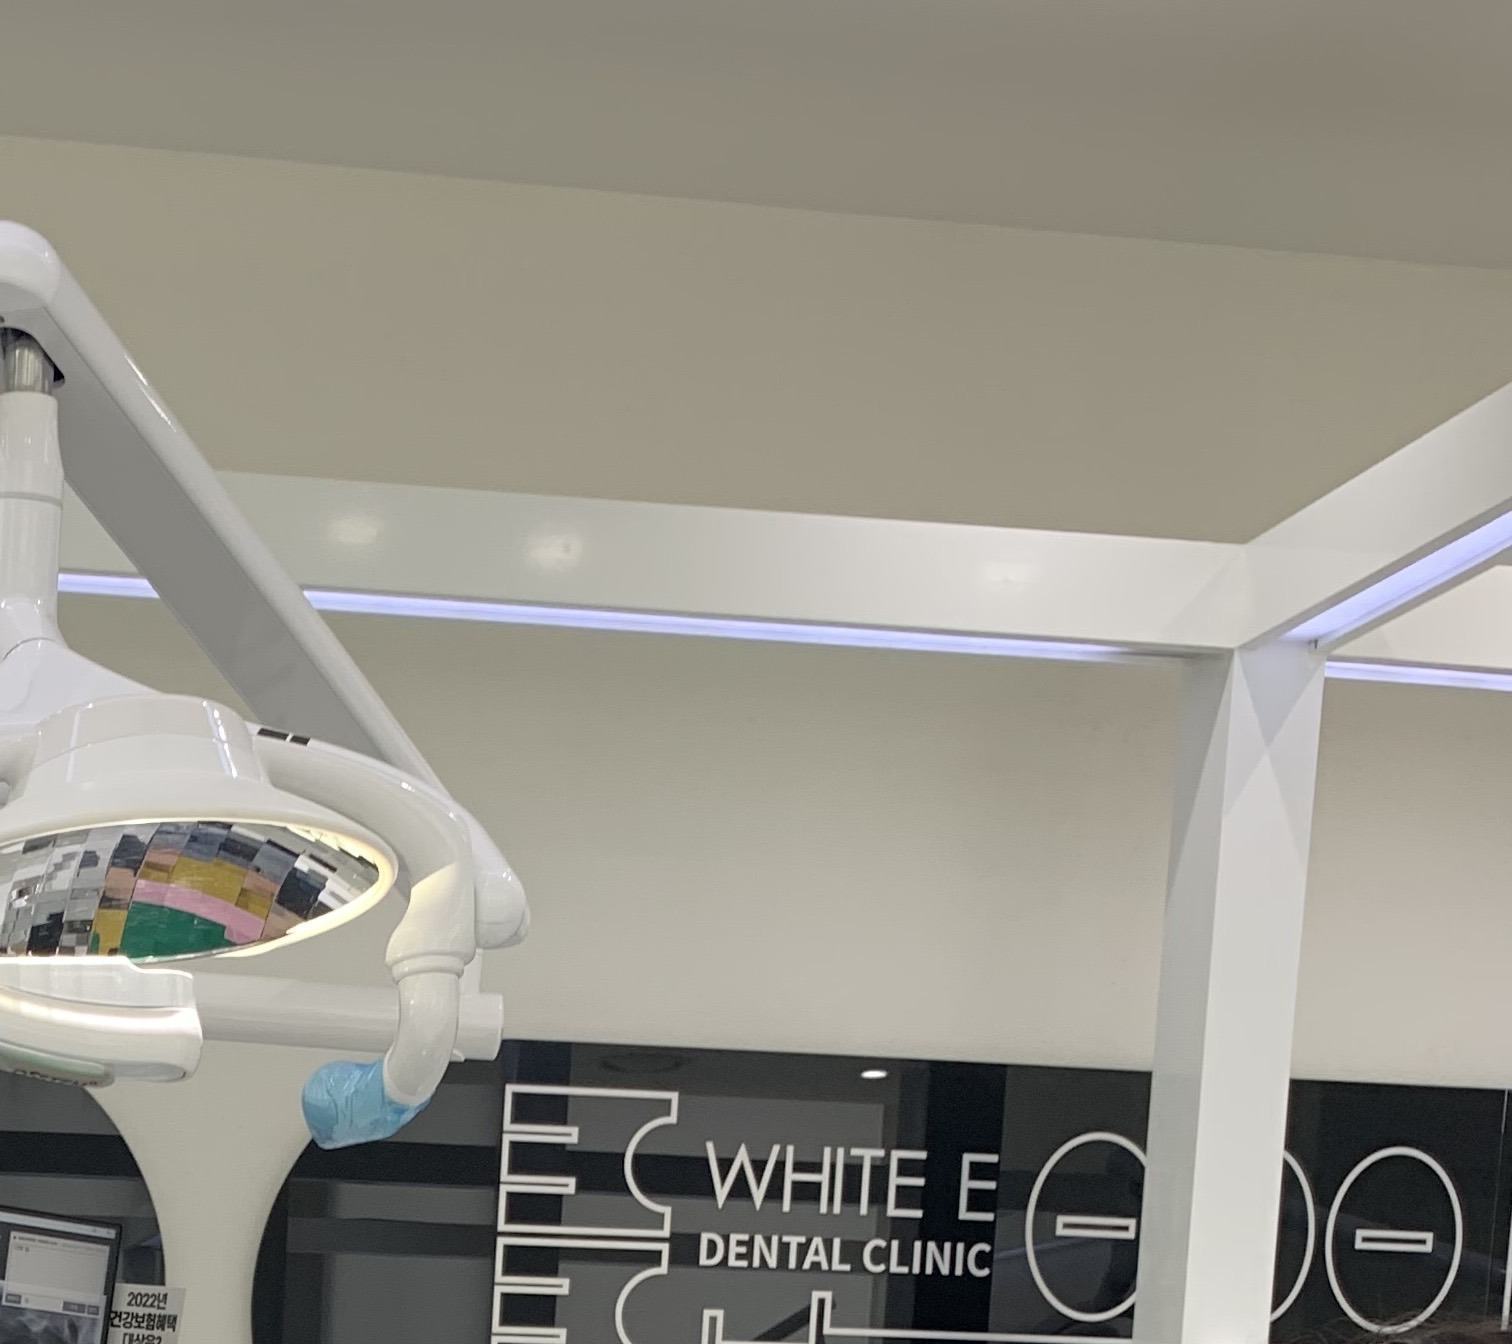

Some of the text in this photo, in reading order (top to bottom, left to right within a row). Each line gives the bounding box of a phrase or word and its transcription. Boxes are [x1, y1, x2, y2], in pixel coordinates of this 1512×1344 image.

[705, 1140, 1000, 1222] WHITE E
[698, 1231, 991, 1277] DENTAL CLINIC
[127, 1292, 168, 1310] 2022년
[109, 1310, 178, 1332] 건강보험혜택
